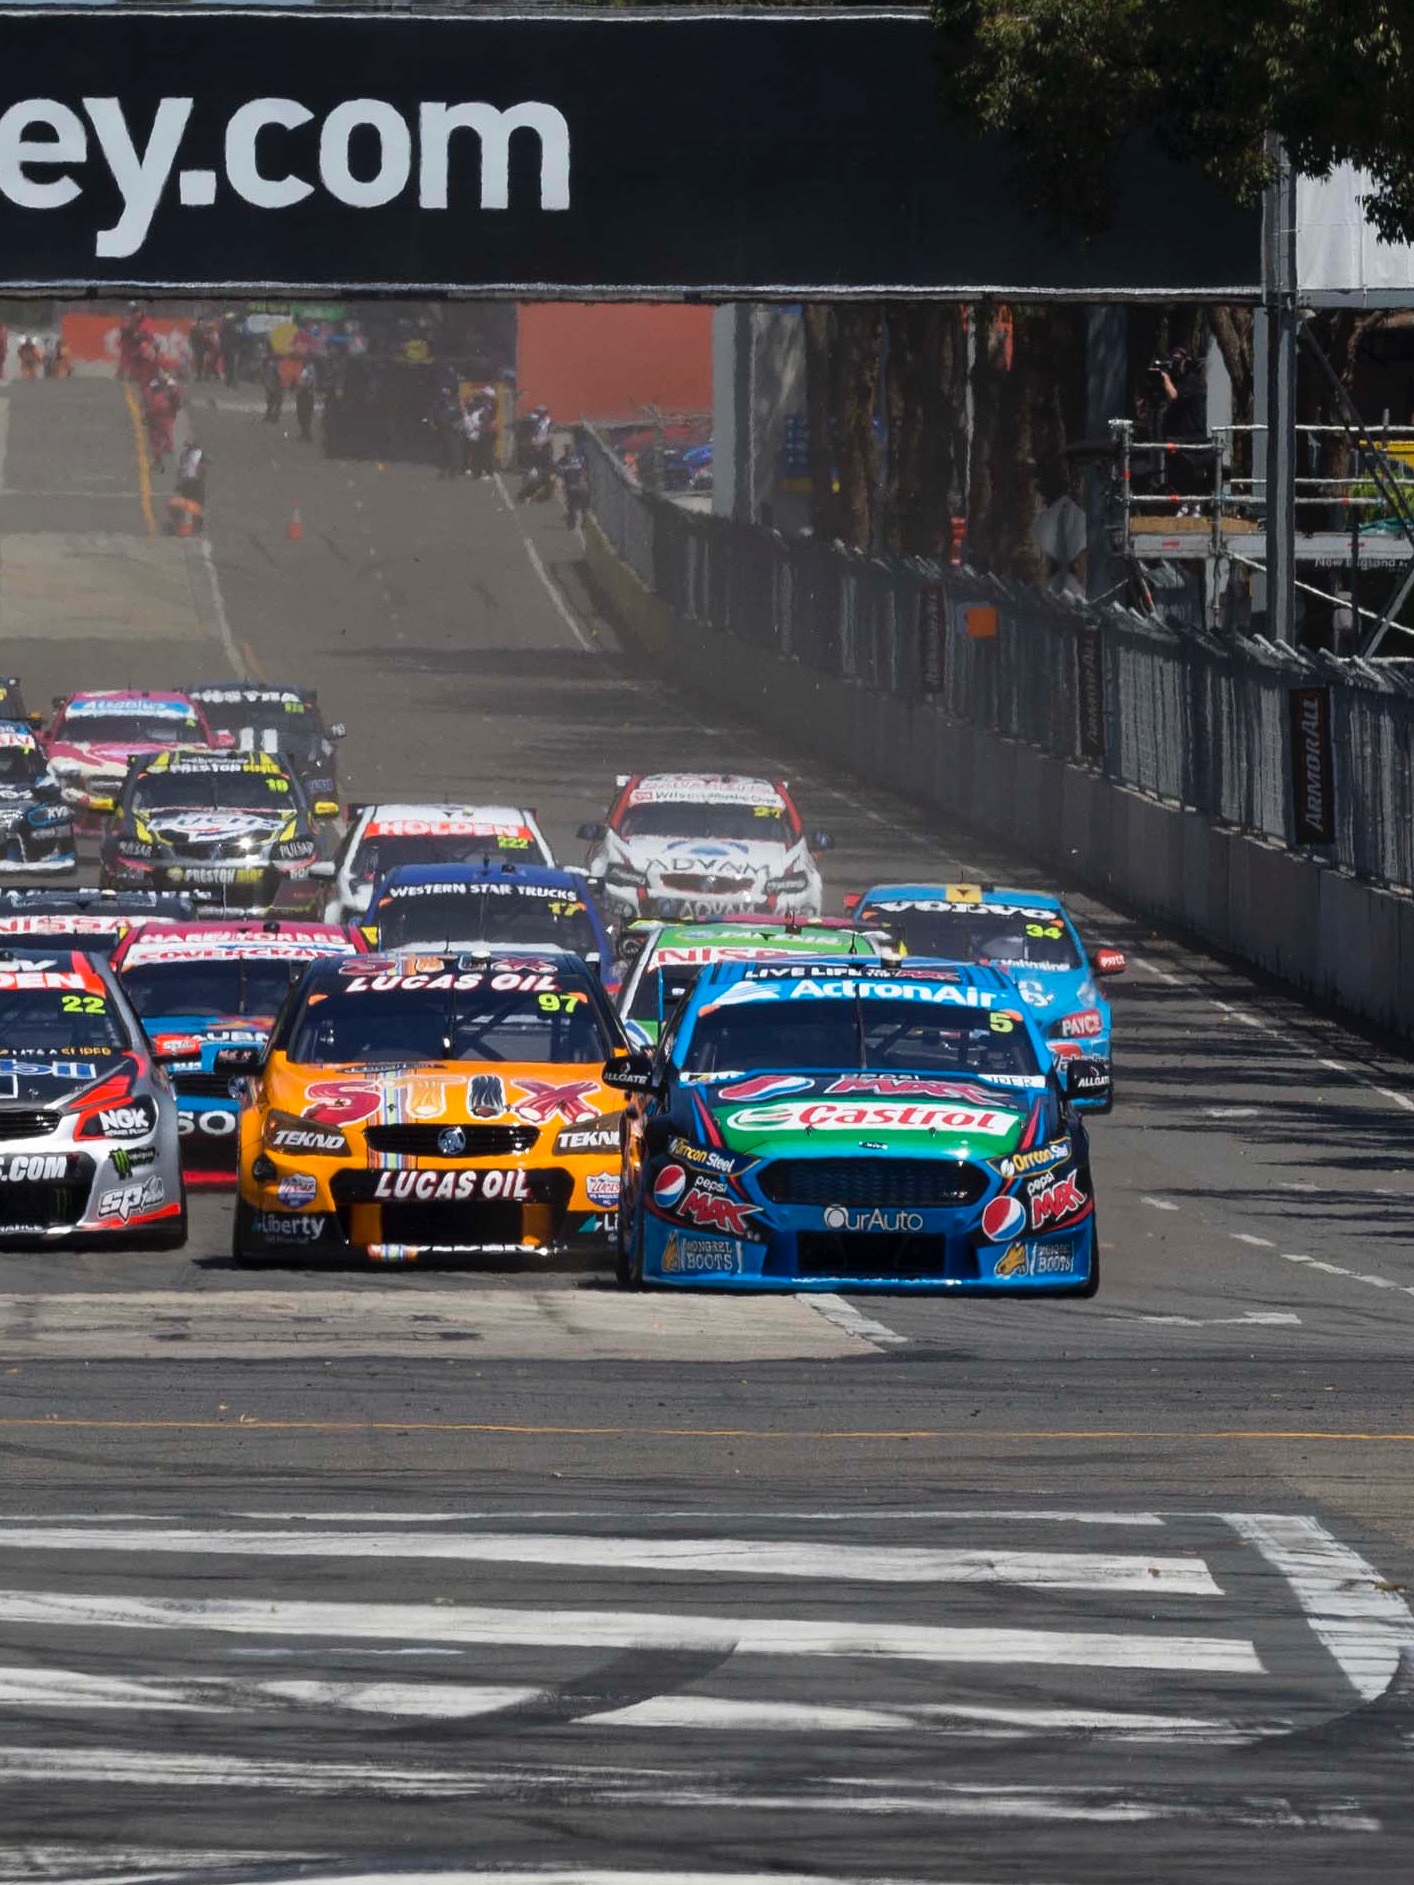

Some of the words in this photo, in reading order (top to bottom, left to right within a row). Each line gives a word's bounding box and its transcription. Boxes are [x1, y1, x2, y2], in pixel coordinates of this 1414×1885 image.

[1301, 697, 1323, 833] ARMORALL
[378, 821, 520, 837] HOLDEN
[389, 882, 467, 899] WESTERN
[470, 882, 513, 896] STAR
[516, 884, 578, 902] TRUCKS
[1025, 923, 1063, 940] 34
[139, 949, 334, 961] COVERCRA
[346, 973, 484, 992] LUCAS
[491, 974, 559, 992] OIL
[745, 967, 805, 978] LIVE
[61, 994, 107, 1014] 22
[538, 993, 580, 1014] 97
[789, 979, 996, 1008] ActronAir
[989, 1011, 1014, 1033] 5
[1061, 1013, 1103, 1037] PAYCE
[1078, 1075, 1111, 1089] ALLGAT
[299, 1073, 605, 1127] STIX
[98, 1107, 151, 1130] NGK
[798, 1103, 997, 1131] Castrol
[272, 1129, 346, 1149] TEKNO
[706, 1151, 736, 1174] Steel
[1013, 1151, 1053, 1171] Orrcon
[374, 1169, 479, 1199] LUCAS
[482, 1168, 531, 1199] OIL
[694, 1175, 728, 1194] pepsi
[1027, 1170, 1054, 1196] pepsi
[1032, 1168, 1087, 1230] MAX
[677, 1188, 764, 1236] MAX
[823, 1204, 924, 1232] OurAuto
[261, 1213, 326, 1240] Liberty
[685, 1253, 734, 1270] BOOTS
